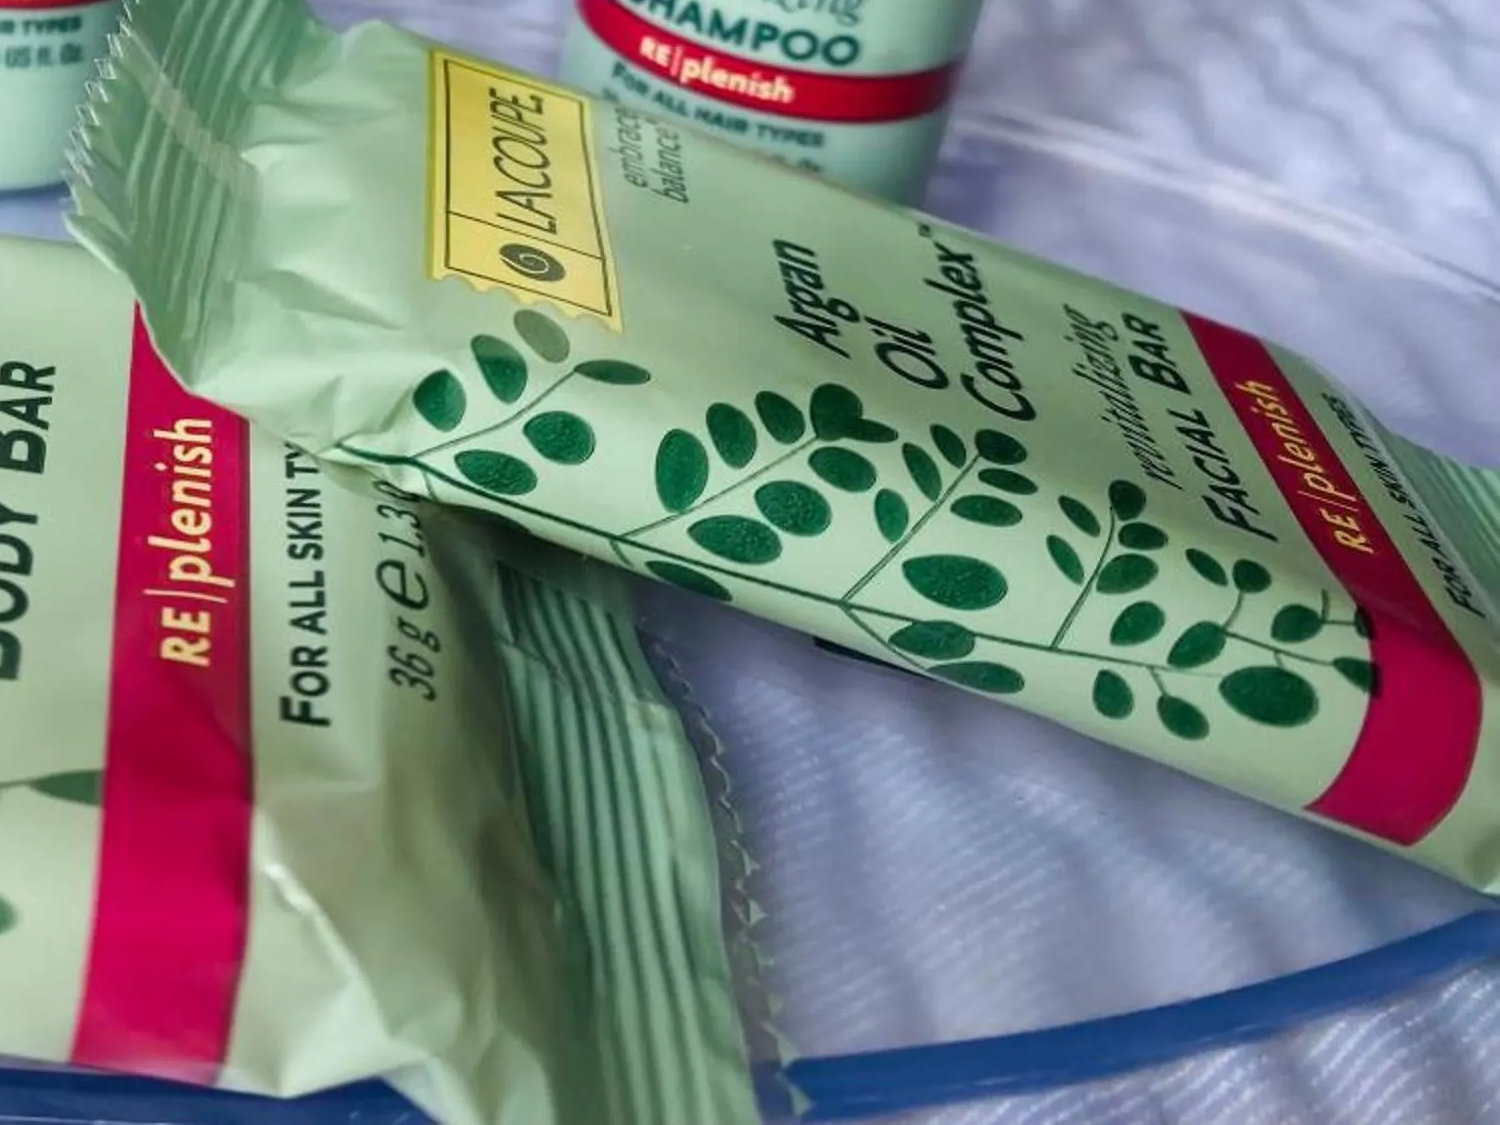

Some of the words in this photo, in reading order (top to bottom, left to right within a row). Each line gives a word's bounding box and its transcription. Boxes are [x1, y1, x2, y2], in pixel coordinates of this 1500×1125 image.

[5, 46, 32, 68] US
[22, 16, 82, 35] TYPES
[612, 61, 650, 96] FOR
[653, 90, 690, 117] ALL
[694, 108, 749, 133] HAIR
[756, 125, 825, 147] TYPES
[488, 87, 558, 236] LACOUPE
[772, 238, 861, 360] Argan
[864, 315, 950, 390] Oil
[1121, 312, 1192, 396] BAR
[1063, 303, 1184, 492] revitalizing
[1321, 392, 1380, 453] TYPES
[1168, 407, 1279, 543] FACIAL
[1364, 453, 1418, 511] SKIN
[285, 488, 325, 561] SKIN
[1403, 512, 1449, 559] ALL
[288, 570, 328, 636] ALL
[1431, 556, 1487, 620] FOR
[397, 615, 441, 653] g
[279, 645, 332, 728] FOR
[386, 644, 438, 702] 36
